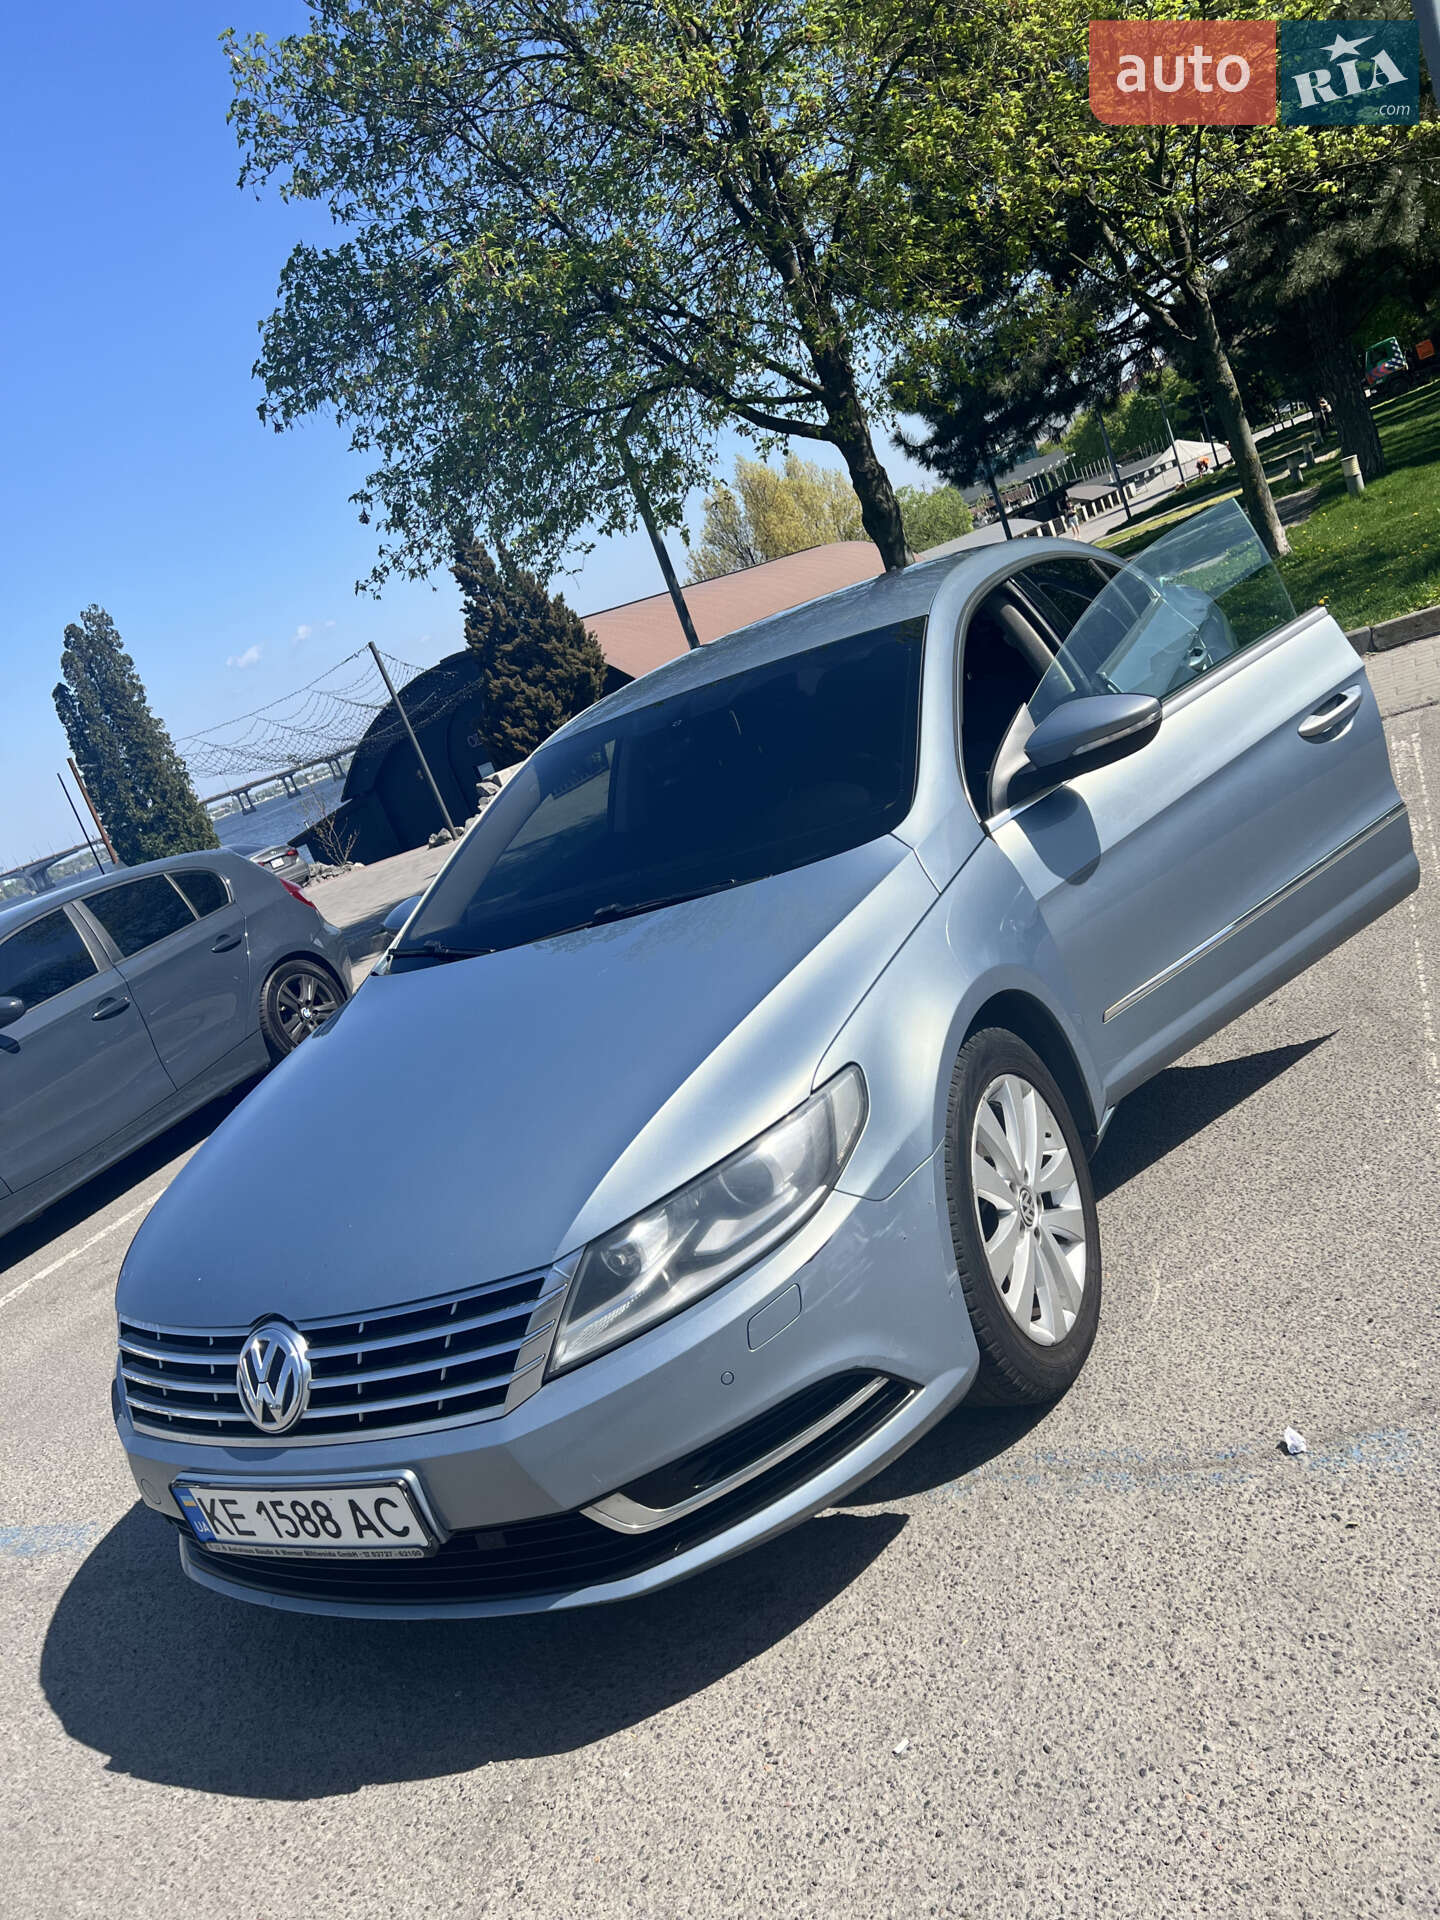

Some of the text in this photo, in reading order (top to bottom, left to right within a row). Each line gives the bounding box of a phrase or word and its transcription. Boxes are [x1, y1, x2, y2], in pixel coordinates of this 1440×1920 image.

[193, 1520, 211, 1533] UA
[197, 1497, 410, 1539] KE 1588 AC
